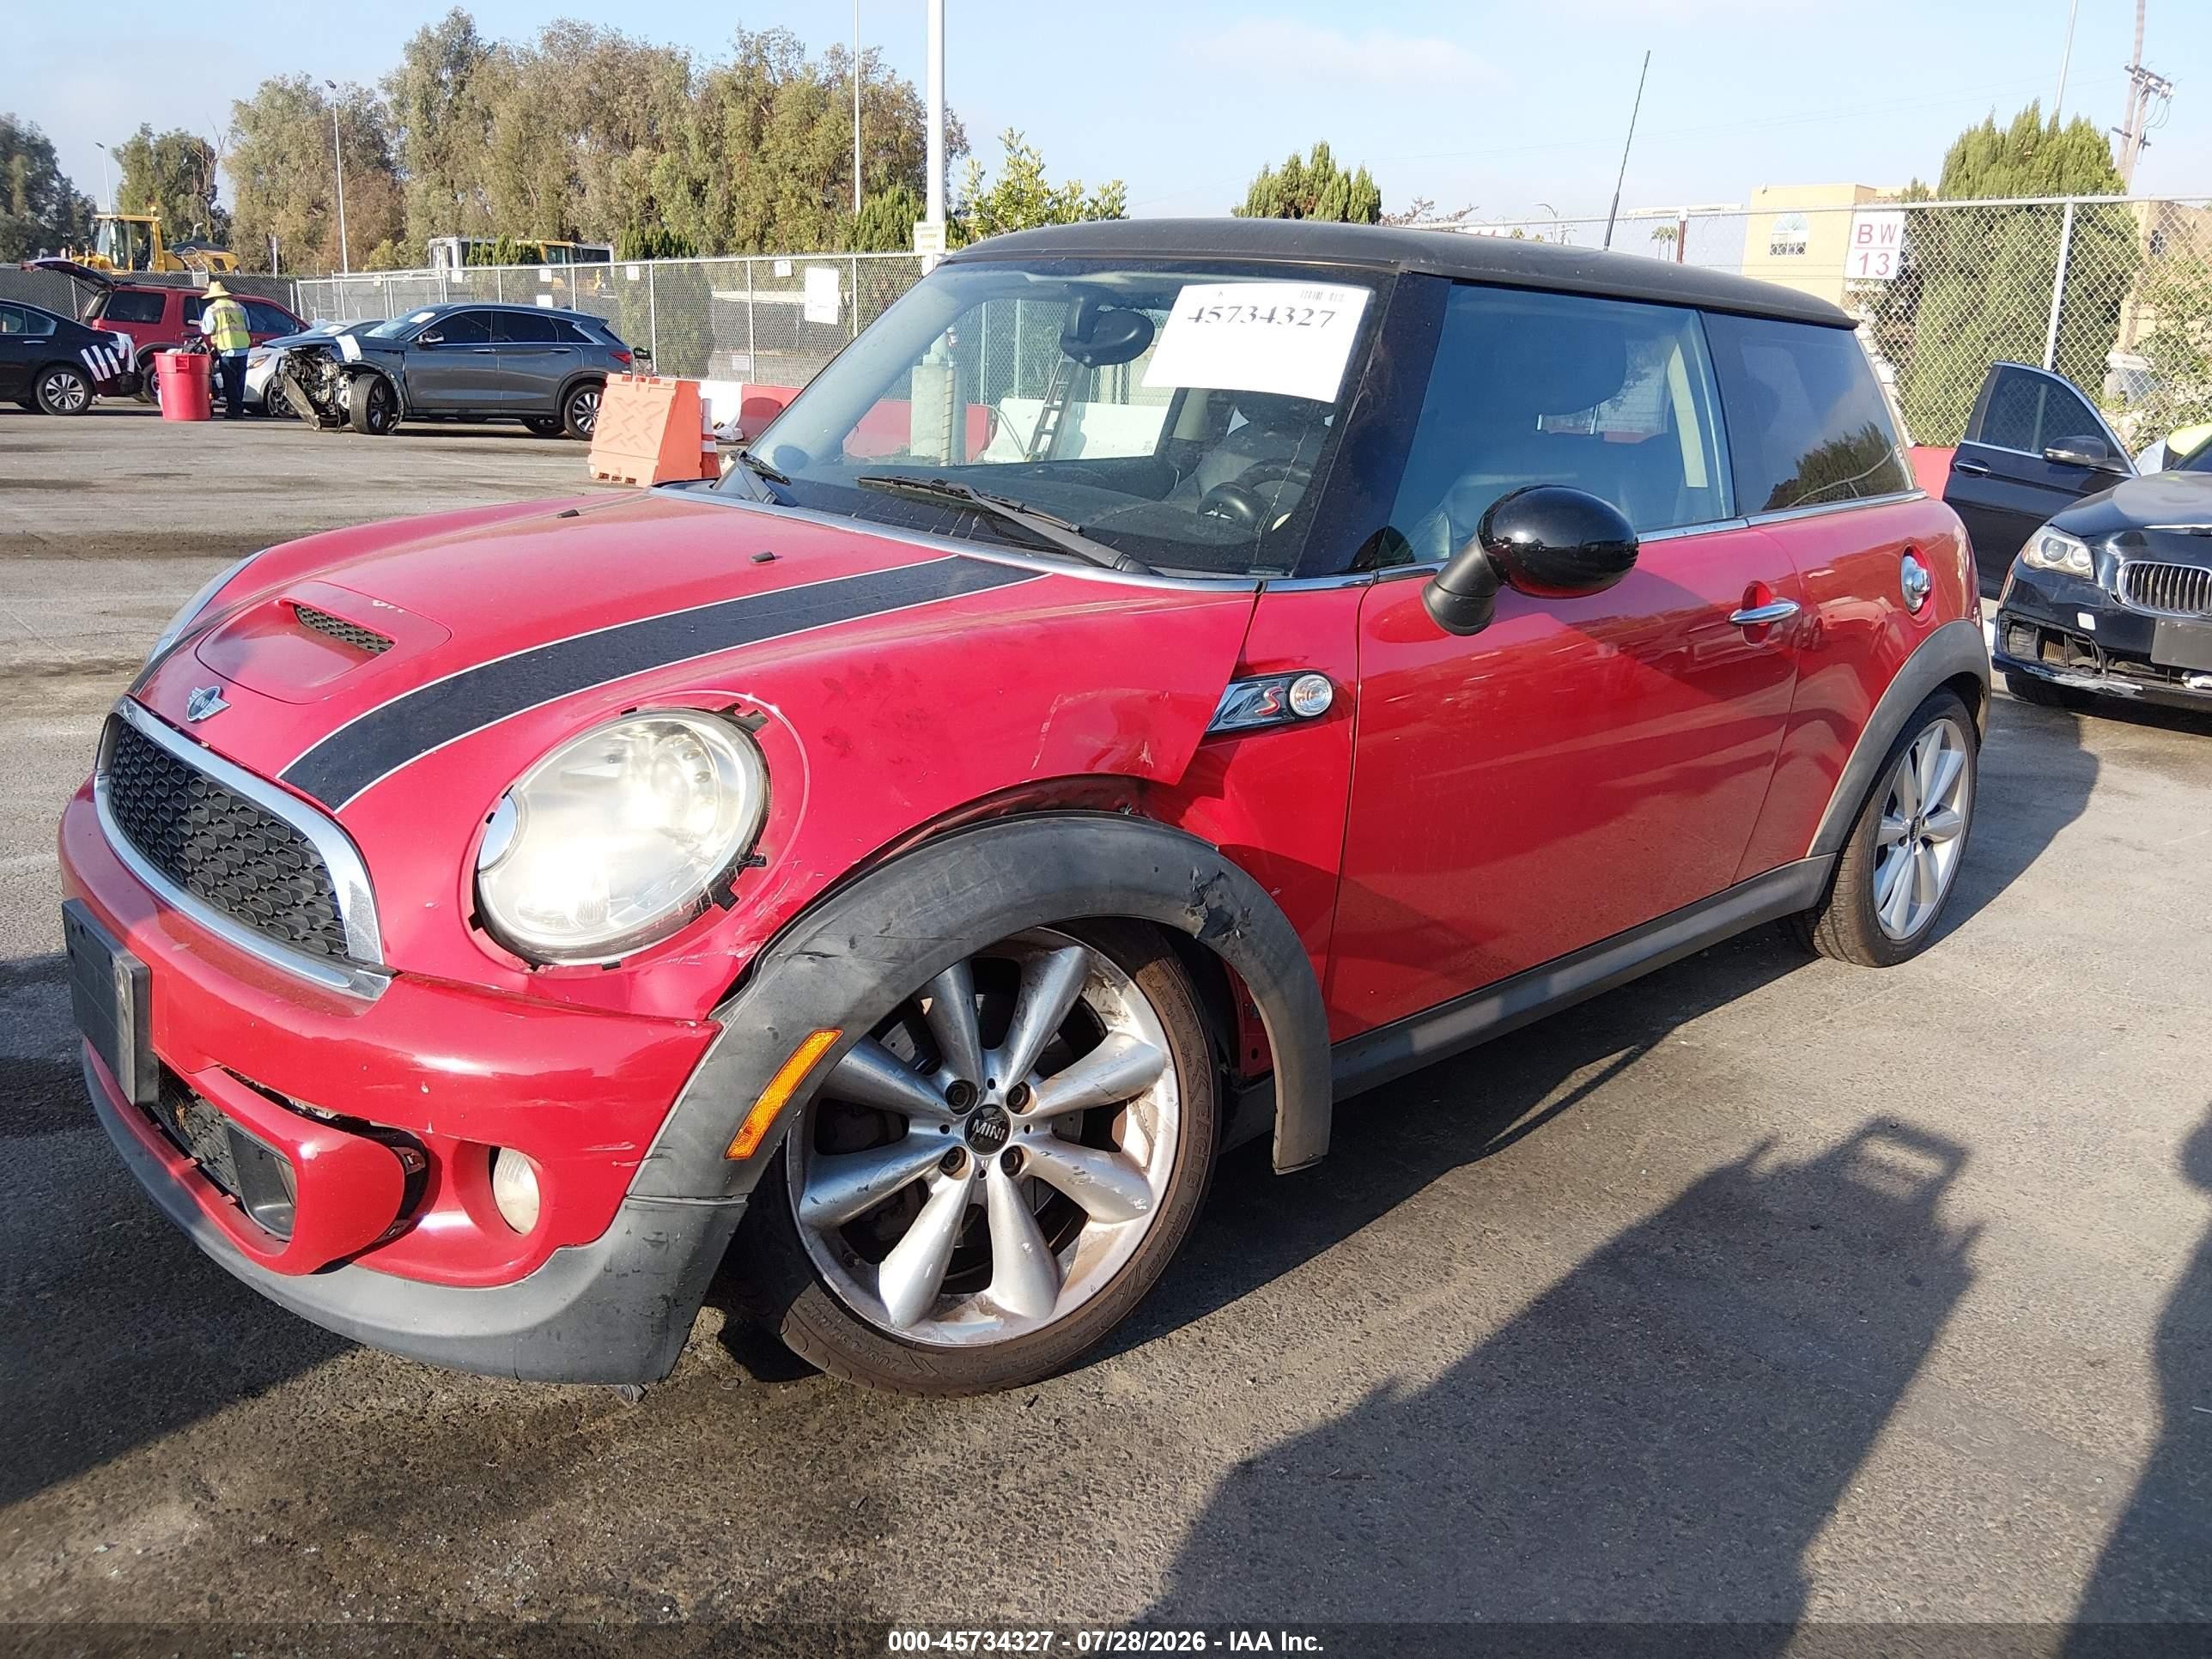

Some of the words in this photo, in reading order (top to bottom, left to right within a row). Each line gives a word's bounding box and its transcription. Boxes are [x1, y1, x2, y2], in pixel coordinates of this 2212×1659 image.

[1858, 252, 1890, 276] 13
[1187, 305, 1337, 329] 45734327
[1255, 685, 1285, 716] S
[971, 1119, 1006, 1142] MINI
[1186, 1103, 1211, 1188] EAGLE
